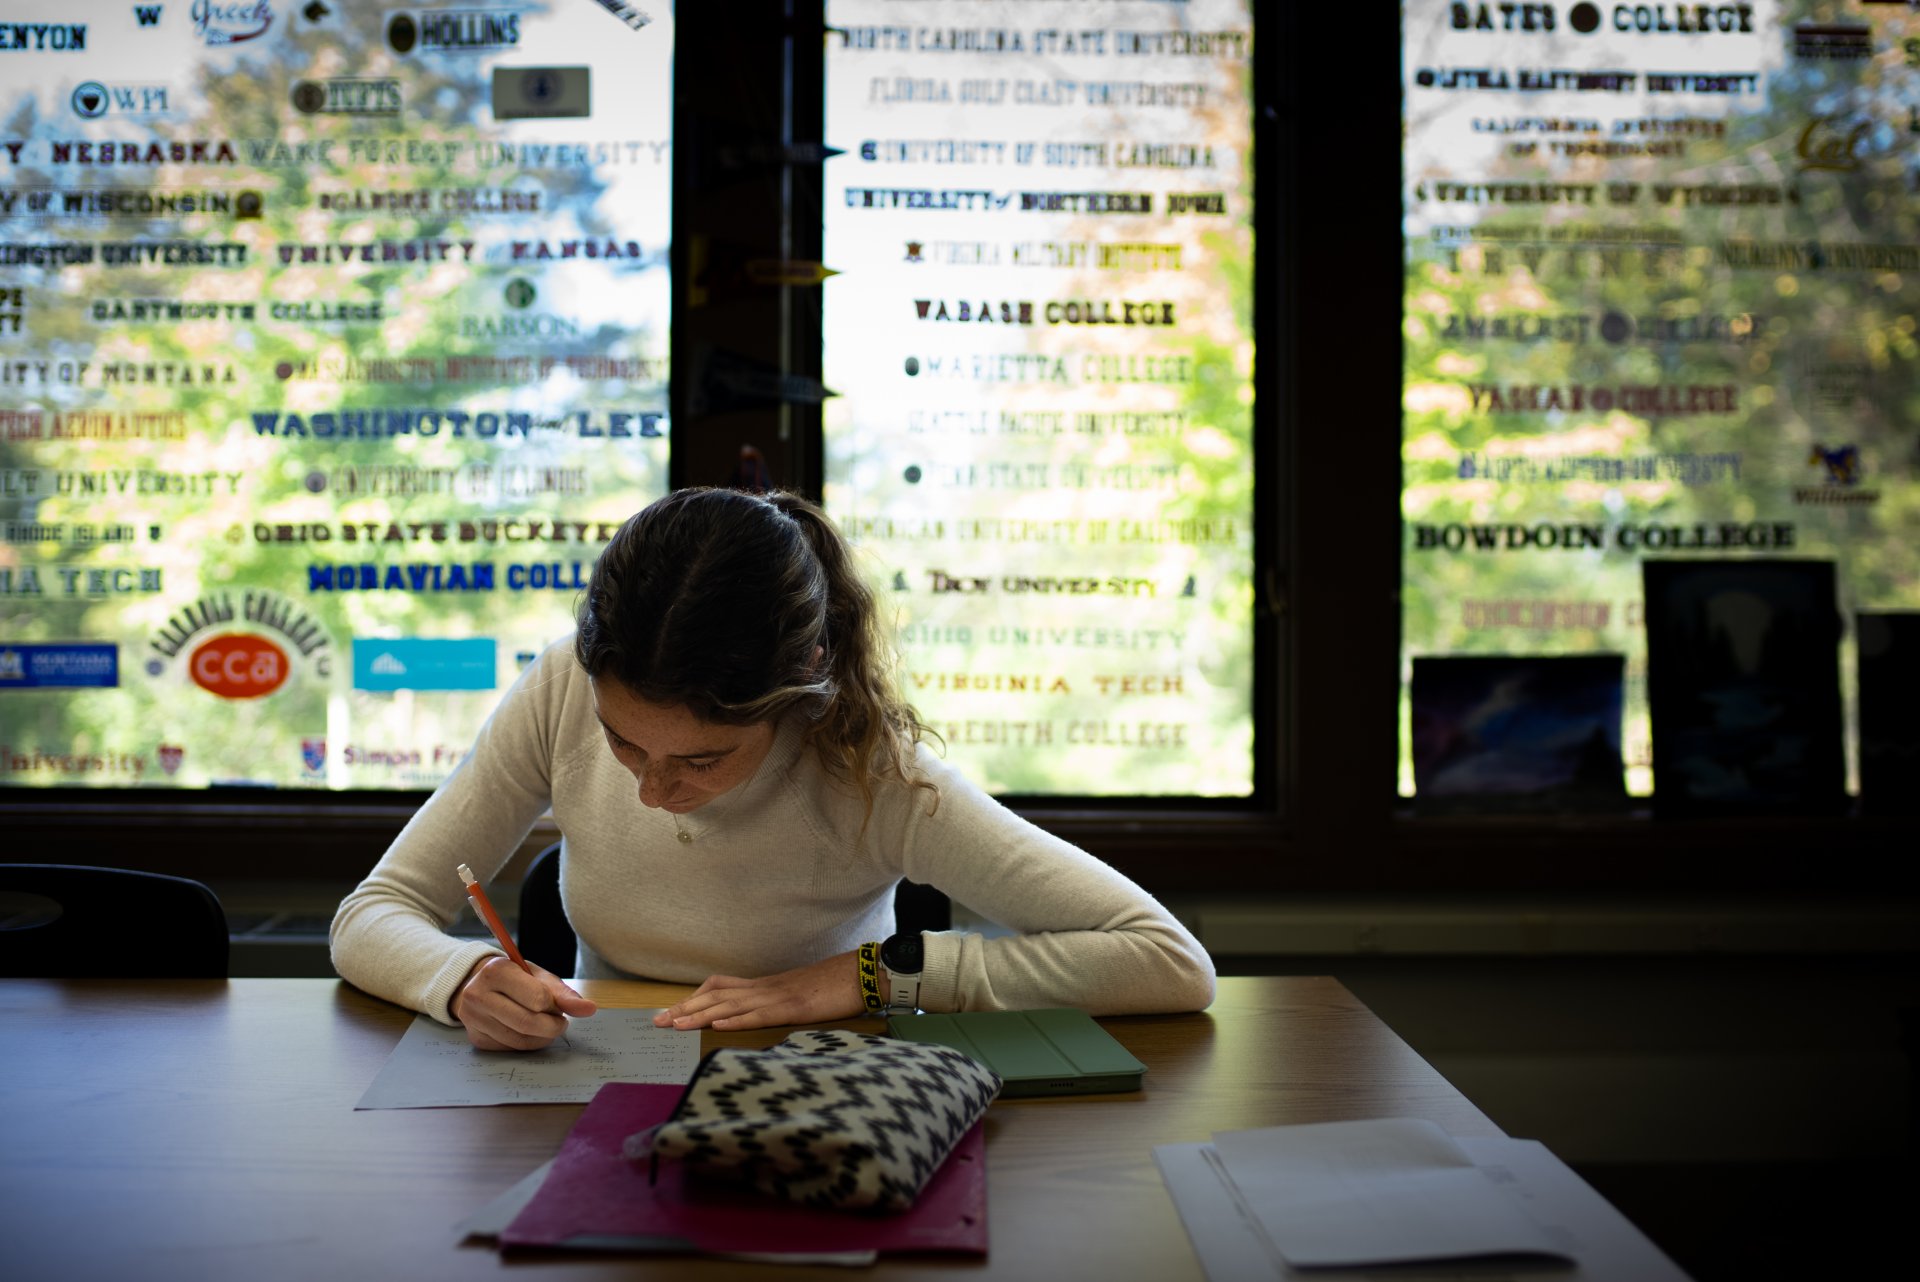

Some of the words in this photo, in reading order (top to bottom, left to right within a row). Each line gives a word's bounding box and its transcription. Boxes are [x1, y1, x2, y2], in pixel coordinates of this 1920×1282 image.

[135, 6, 162, 26] W
[1451, 3, 1556, 31] BATES
[1614, 3, 1755, 32] COLLEGE
[421, 14, 520, 45] HOLLINS
[918, 28, 1025, 52] CAROLINA
[1031, 29, 1105, 55] STATE
[1115, 31, 1246, 58] UNIVERSITY
[112, 87, 169, 110] WPI
[871, 77, 952, 103] FLORIDA
[1015, 79, 1076, 105] COAST
[1084, 80, 1208, 106] UNIVERSITY
[52, 141, 238, 165] NEBRASKA
[350, 139, 464, 164] FOREST
[475, 141, 669, 166] UNIVERSITY
[885, 141, 1003, 163] UNIVERSITY
[1045, 142, 1108, 166] SOUTH
[1116, 143, 1216, 168] CAROLINA
[63, 190, 230, 212] WISCONSIN
[320, 190, 430, 213] ROANOKE
[440, 190, 542, 212] COLLEGE
[846, 188, 992, 210] UNIVERSITY
[1022, 192, 1154, 213] NORTHERN
[1167, 193, 1226, 214] IOWA
[1434, 182, 1596, 203] UNIVERSITY
[101, 244, 247, 264] UNIVERSITY
[278, 241, 476, 263] UNIVERSITY
[511, 241, 641, 260] KANSAS
[93, 302, 255, 321] DARTMOUTH
[270, 301, 384, 321] COLLEGE
[915, 300, 1033, 326] WABASH
[1045, 301, 1176, 326] COLLEGE
[462, 314, 579, 338] BABSON
[58, 362, 89, 385] OF
[103, 363, 237, 385] MONTANA
[927, 355, 1069, 384] MARIETTA
[1083, 355, 1195, 383] COLLEGE
[1618, 385, 1740, 414] COLLEGE
[252, 410, 530, 437] WASHINGTON
[578, 411, 664, 437] LEE
[1076, 411, 1187, 435] UNIVERSITY
[56, 471, 243, 495] UNIVERSITY
[333, 466, 457, 495] UNIVERSITY
[502, 467, 587, 494] ILLINOIS
[5, 524, 63, 542] RHODE
[73, 524, 134, 542] ISLAND
[254, 523, 331, 543] OHIO
[342, 523, 448, 543] STATE
[958, 517, 1081, 542] UNIVERSITY
[1117, 519, 1237, 545] CALIFORNIA
[1415, 522, 1603, 551] BOWDOIN
[1616, 521, 1797, 551] COLLEGE
[58, 567, 161, 593] TECH
[308, 563, 494, 592] MORAVIAN
[1001, 573, 1157, 596] UNIVERSITY
[988, 625, 1187, 648] UNIVERSITY
[196, 650, 279, 684] cca
[910, 672, 1071, 695] VIRGINIA
[1093, 673, 1186, 695] TECH
[1066, 720, 1187, 748] COLLEGE
[343, 744, 422, 768] Simon
